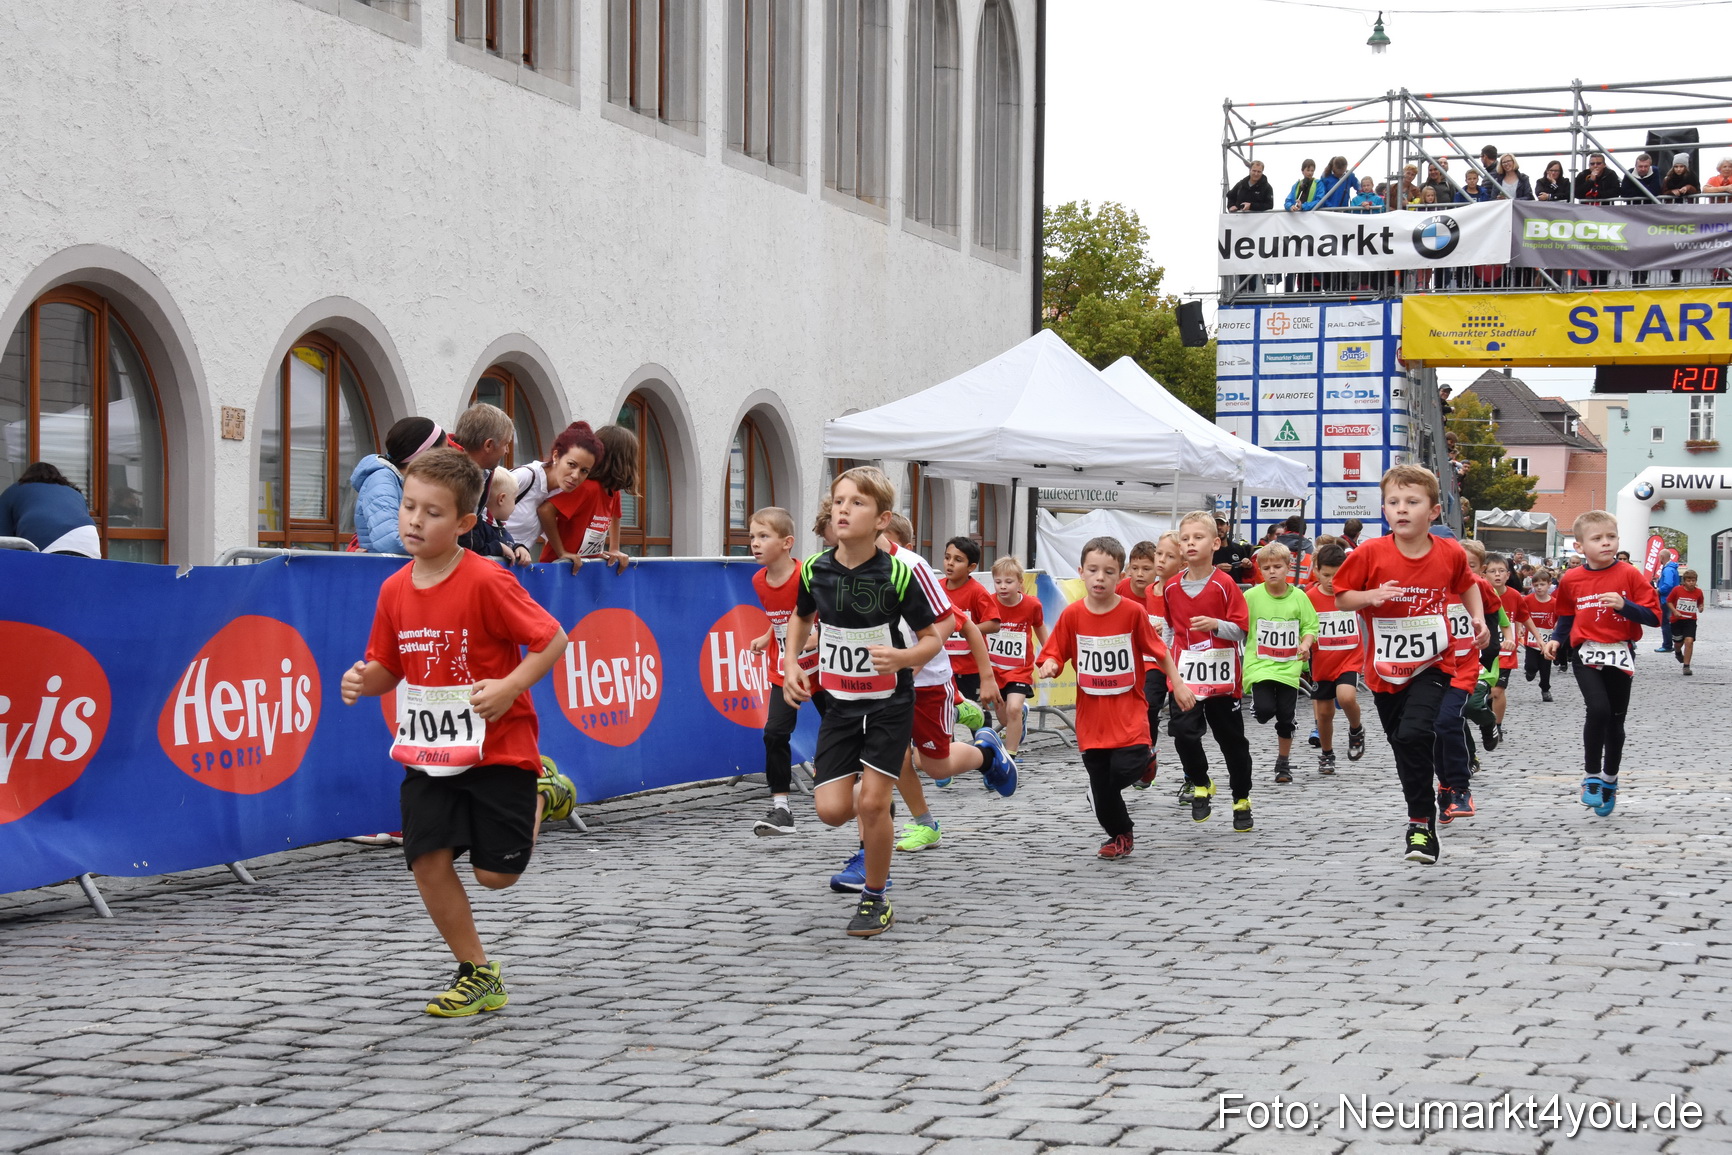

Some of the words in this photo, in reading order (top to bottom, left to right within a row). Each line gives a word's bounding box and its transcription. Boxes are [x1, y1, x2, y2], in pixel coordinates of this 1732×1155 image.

[1525, 220, 1624, 242] BOCK
[1647, 223, 1696, 236] OFFICE
[1218, 224, 1394, 260] Neumarkt
[1522, 241, 1553, 250] inspired
[1555, 242, 1564, 250] by
[1592, 244, 1629, 252] concepts
[1674, 239, 1732, 250] www.bo
[1292, 322, 1314, 330] CLINIC
[1429, 328, 1488, 338] Neumarkter
[1490, 327, 1537, 338] Stadtlauf
[1673, 367, 1719, 391] 1:20
[1276, 392, 1314, 400] VARIOTEC
[1661, 474, 1714, 489] BMW
[1645, 539, 1662, 572] REWE
[1319, 619, 1355, 636] 7140
[1402, 617, 1438, 628] BOCK
[846, 630, 885, 641] BOCK
[1261, 630, 1296, 646] 7010
[990, 638, 1022, 656] 7403
[1381, 632, 1438, 658] 7251
[826, 643, 881, 672] 702
[1082, 648, 1129, 673] 7090
[564, 640, 658, 718] Hervis
[1185, 661, 1230, 682] 7018
[841, 678, 872, 690] Niklas
[1092, 678, 1118, 686] Niklas
[174, 657, 312, 756] Hervis
[408, 708, 473, 742] 7041
[581, 710, 629, 730] SPORTS
[0, 675, 97, 784] vis
[192, 746, 262, 773] SPORTS
[416, 750, 450, 763] Robin
